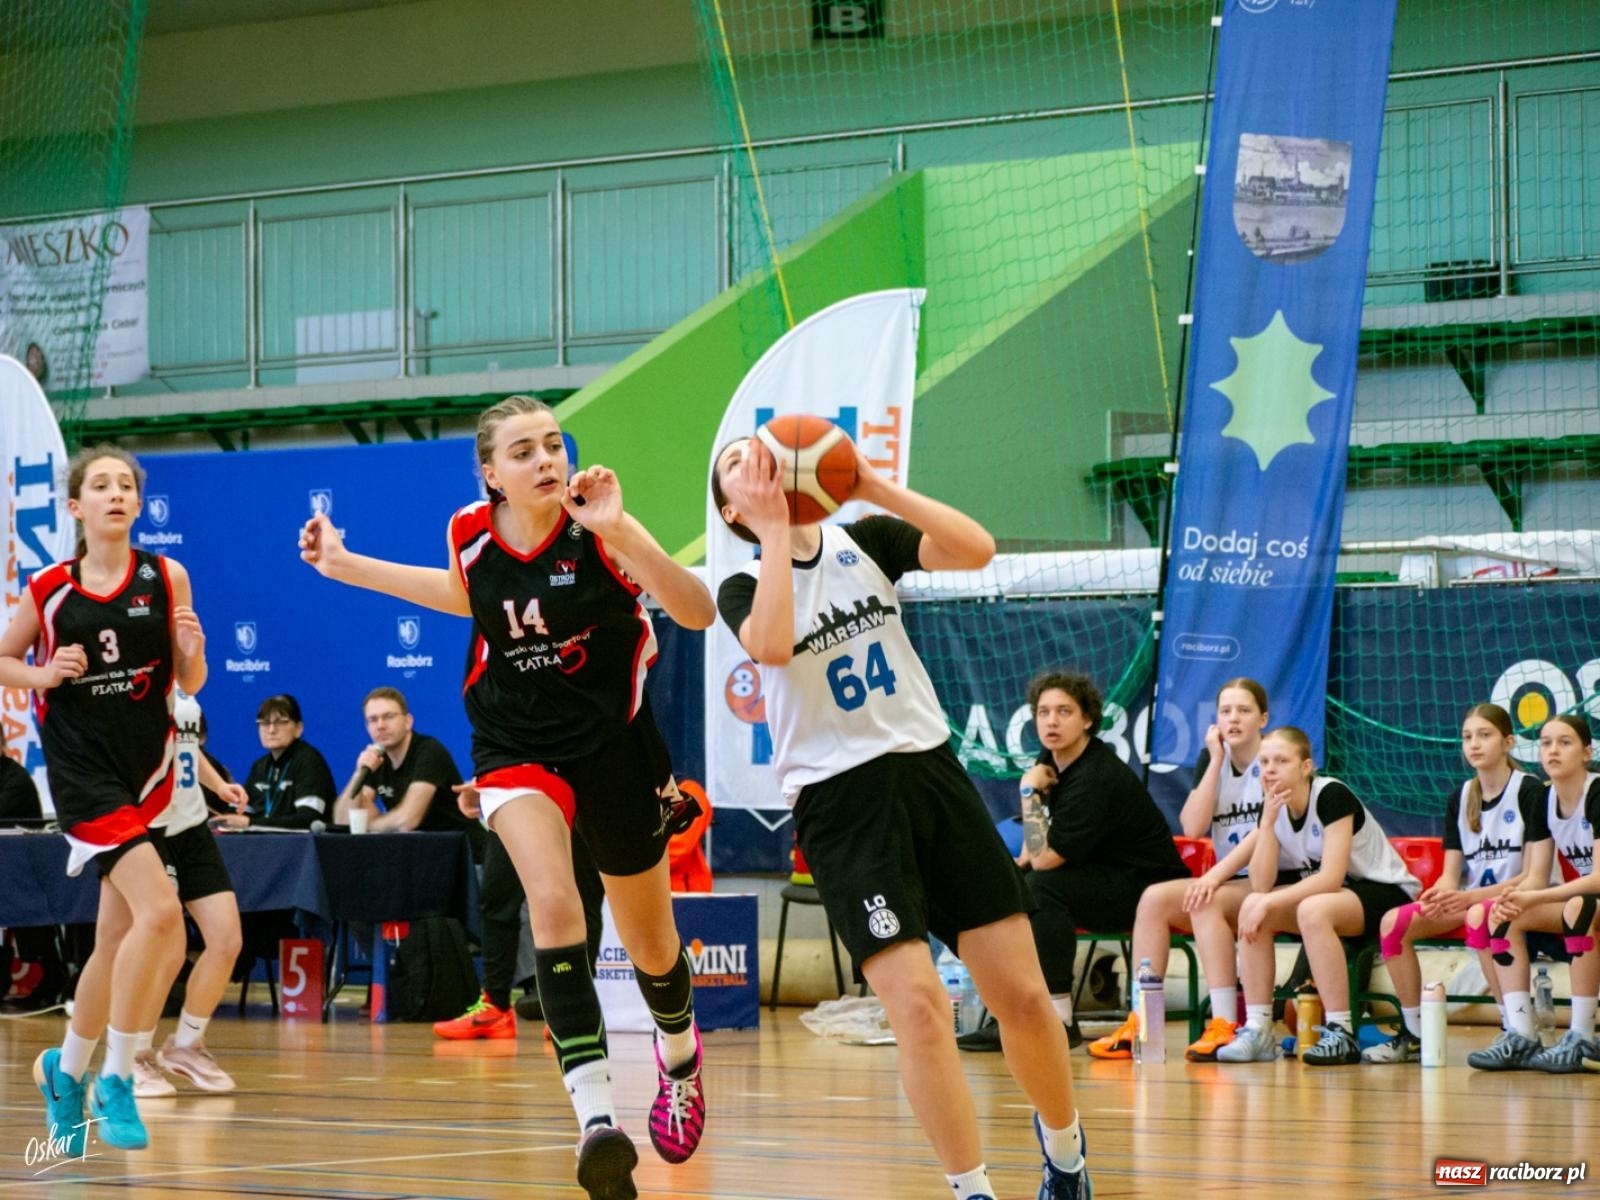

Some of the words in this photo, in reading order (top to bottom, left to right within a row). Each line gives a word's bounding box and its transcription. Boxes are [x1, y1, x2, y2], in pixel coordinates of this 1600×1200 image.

[830, 6, 867, 32] B
[138, 531, 184, 546] Racibórz
[1183, 526, 1259, 561] Dodaj
[1266, 535, 1310, 560] coś
[1178, 558, 1208, 582] od
[1209, 560, 1274, 587] siebie
[502, 597, 550, 640] 14
[807, 609, 886, 657] WARSAW
[98, 628, 121, 665] 3
[386, 654, 433, 668] Racibórz
[225, 658, 271, 672] Racibórz
[826, 640, 897, 713] 64
[863, 894, 887, 913] LO
[282, 946, 309, 998] 5
[685, 943, 749, 976] MINI
